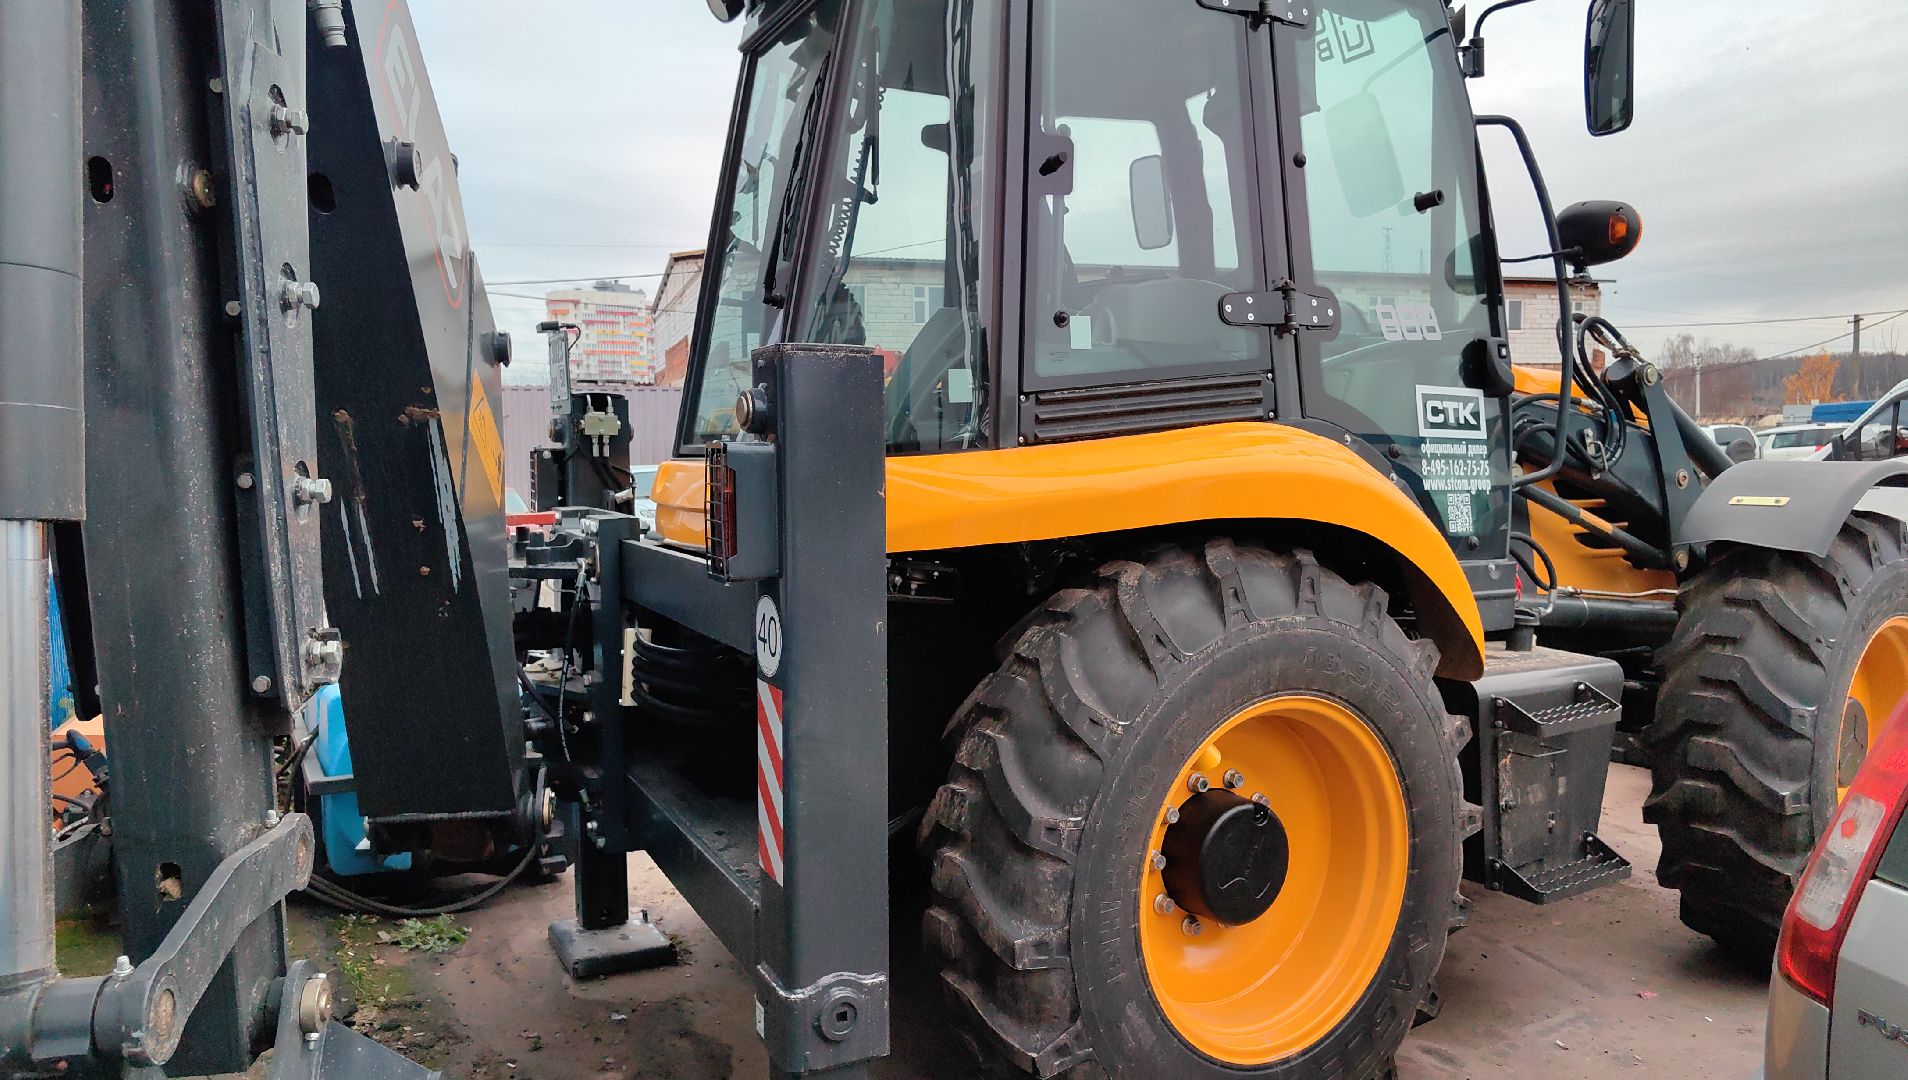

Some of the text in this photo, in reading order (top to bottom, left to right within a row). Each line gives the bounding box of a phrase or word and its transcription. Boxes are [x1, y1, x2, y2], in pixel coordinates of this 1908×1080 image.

[1425, 399, 1478, 427] СТК
[1420, 439, 1488, 458] официальный дилер
[1421, 459, 1490, 476] 8-495-162-75-75
[1422, 477, 1492, 495] www.stcom.group
[757, 612, 778, 658] 40
